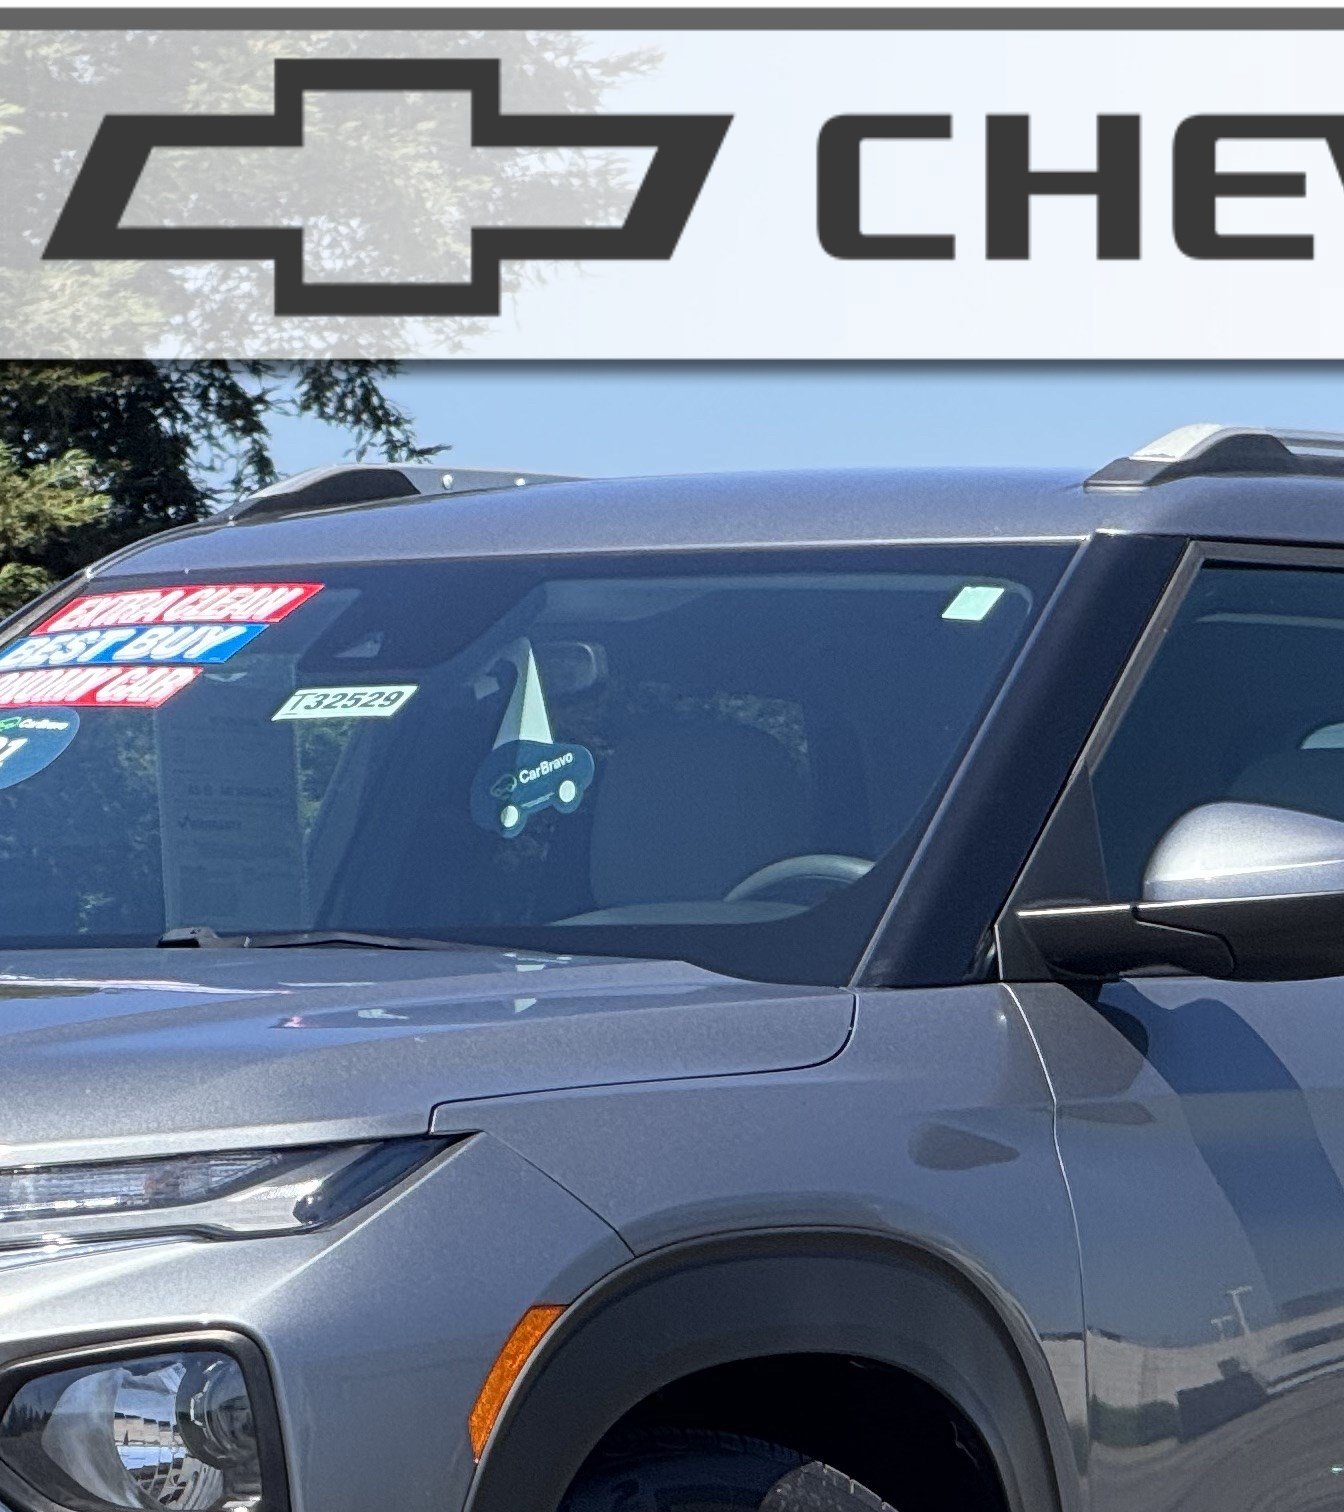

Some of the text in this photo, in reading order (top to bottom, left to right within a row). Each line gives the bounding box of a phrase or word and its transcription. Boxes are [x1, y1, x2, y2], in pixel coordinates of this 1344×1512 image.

[47, 587, 305, 632] EXTRA CLEAN
[111, 625, 248, 661] BUY
[96, 667, 197, 703] CAR
[289, 691, 405, 712] T32529
[518, 752, 574, 784] CarBravo
